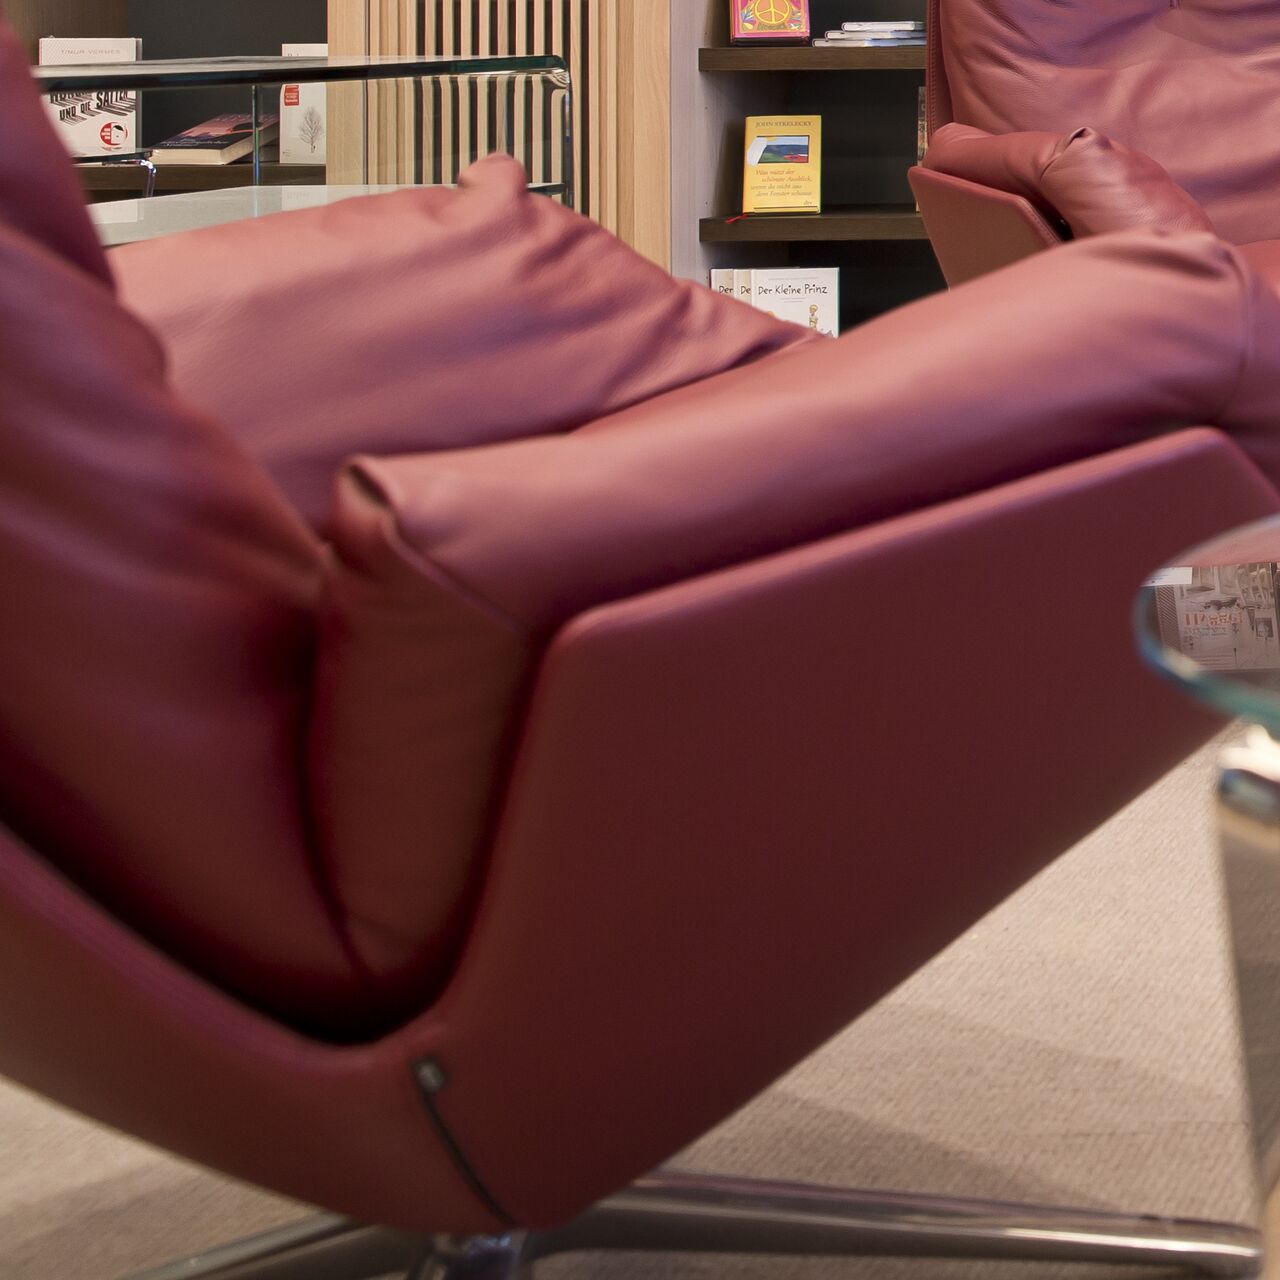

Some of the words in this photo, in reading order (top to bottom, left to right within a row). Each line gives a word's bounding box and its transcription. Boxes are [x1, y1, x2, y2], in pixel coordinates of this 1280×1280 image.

[59, 107, 77, 121] UND
[718, 286, 733, 294] Der
[741, 286, 751, 294] De
[758, 286, 773, 295] Der
[775, 284, 802, 295] Kleine
[804, 283, 828, 295] Prinz
